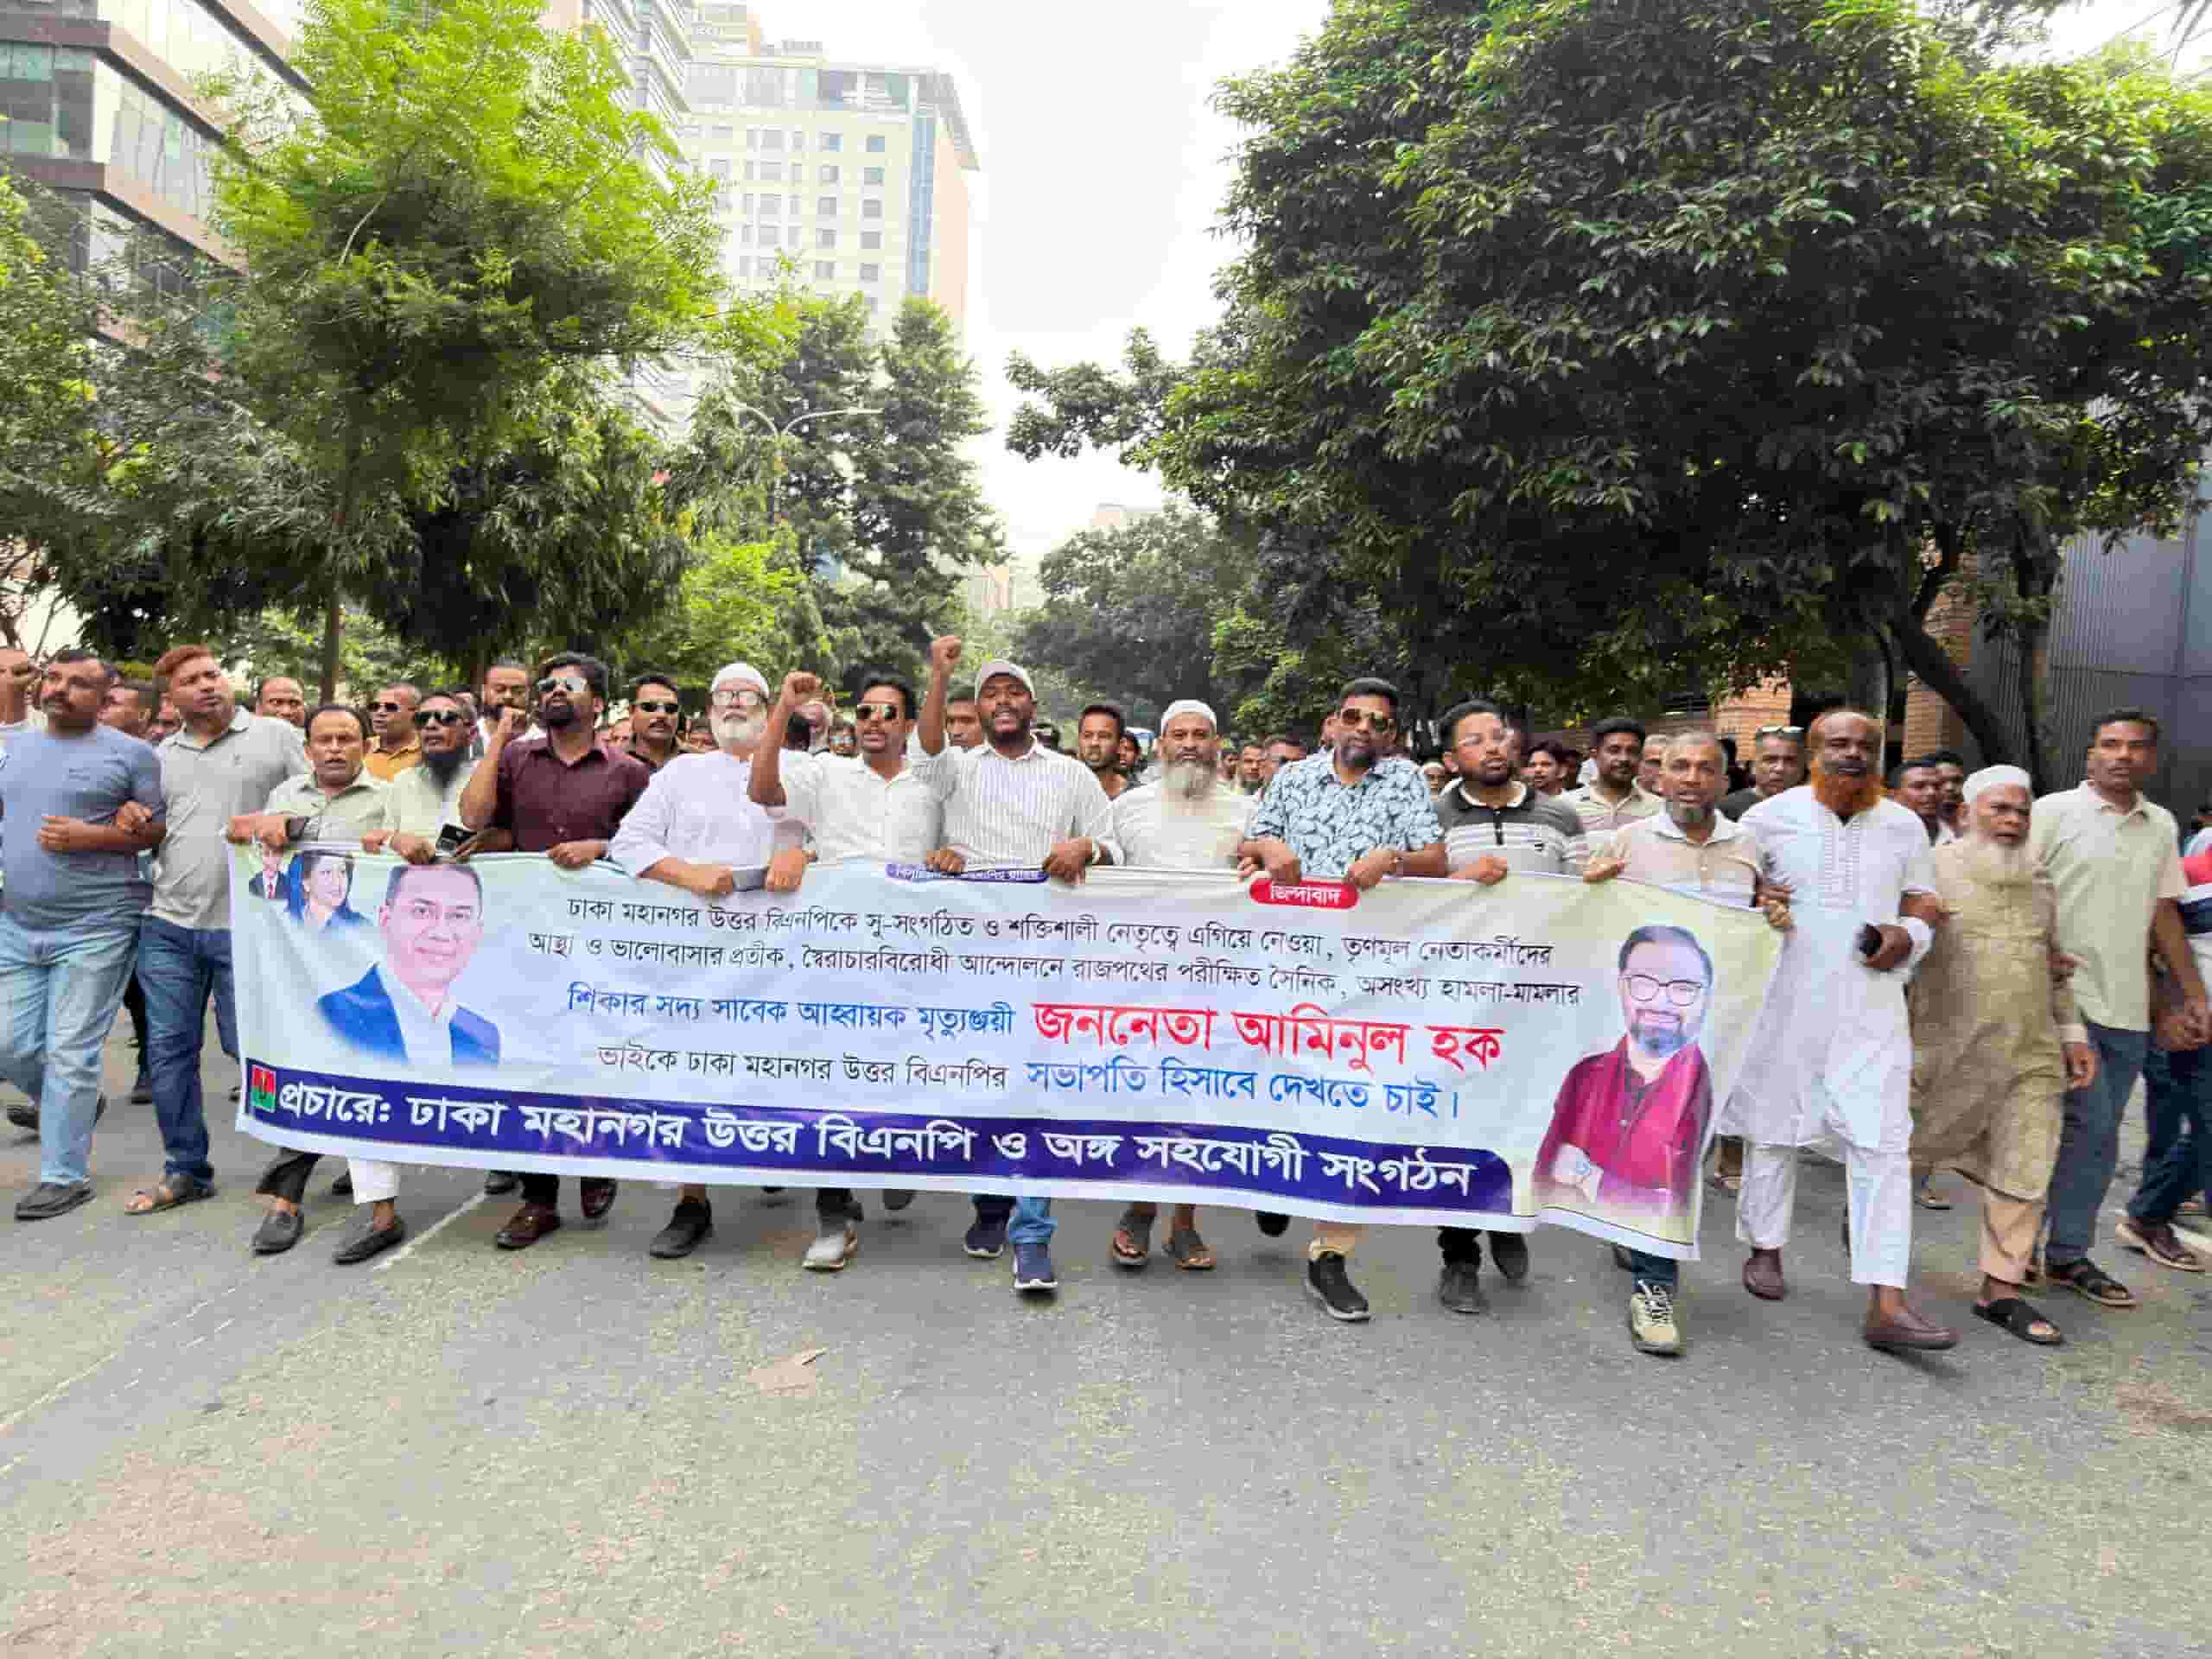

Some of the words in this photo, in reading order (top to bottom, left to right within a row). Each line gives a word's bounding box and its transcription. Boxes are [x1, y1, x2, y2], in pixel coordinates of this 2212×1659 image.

[567, 898, 614, 921] ঢাকা
[621, 902, 700, 927] মহানগর
[707, 905, 756, 931] উত্তর
[766, 906, 858, 933] বিএনপিকে
[865, 907, 975, 938] সু-সংগঠিত
[983, 918, 1000, 938] ও
[1007, 913, 1098, 940] শক্তিশালী
[1107, 923, 1181, 953] নেতৃত্বে
[1188, 921, 1254, 949] এগিয়ে
[1341, 934, 1411, 966] তৃণমূল
[1420, 934, 1554, 967] নেতাকর্মীদের
[587, 938, 603, 957] ও
[610, 939, 726, 966] ভালোবাসার
[958, 953, 1065, 978] আন্দোলনে
[1071, 959, 1168, 982] রাজপথের
[1177, 957, 1262, 987] পরীক্ষিত
[1356, 975, 1432, 1001] অসংখ্য
[567, 982, 650, 1017] শিকার
[657, 995, 705, 1021] সদ্য
[711, 998, 788, 1023] সাবেক
[1030, 1002, 1219, 1051] জননেতা
[1230, 1001, 1415, 1075] আমিনুল
[1424, 1025, 1507, 1071] হক
[596, 1037, 677, 1072] ভাইকে
[685, 1050, 736, 1076] ঢাকা
[742, 1054, 836, 1082] মহানগর
[842, 1052, 899, 1085] উত্তর
[906, 1055, 1009, 1091] বিএনপির
[1023, 1054, 1151, 1093] সভাপতি
[1158, 1056, 1258, 1099] হিসাবে
[1269, 1074, 1375, 1108] দেখতে
[405, 1096, 511, 1136] ঢাকা
[518, 1105, 691, 1148] মহানগর
[702, 1106, 805, 1155] উত্তর
[814, 1113, 979, 1161] বিএনপি
[992, 1132, 1028, 1160] ও
[1039, 1132, 1124, 1167] অঙ্গ
[1132, 1133, 1312, 1182] সহযোগী
[1318, 1147, 1478, 1197] সংগঠন
